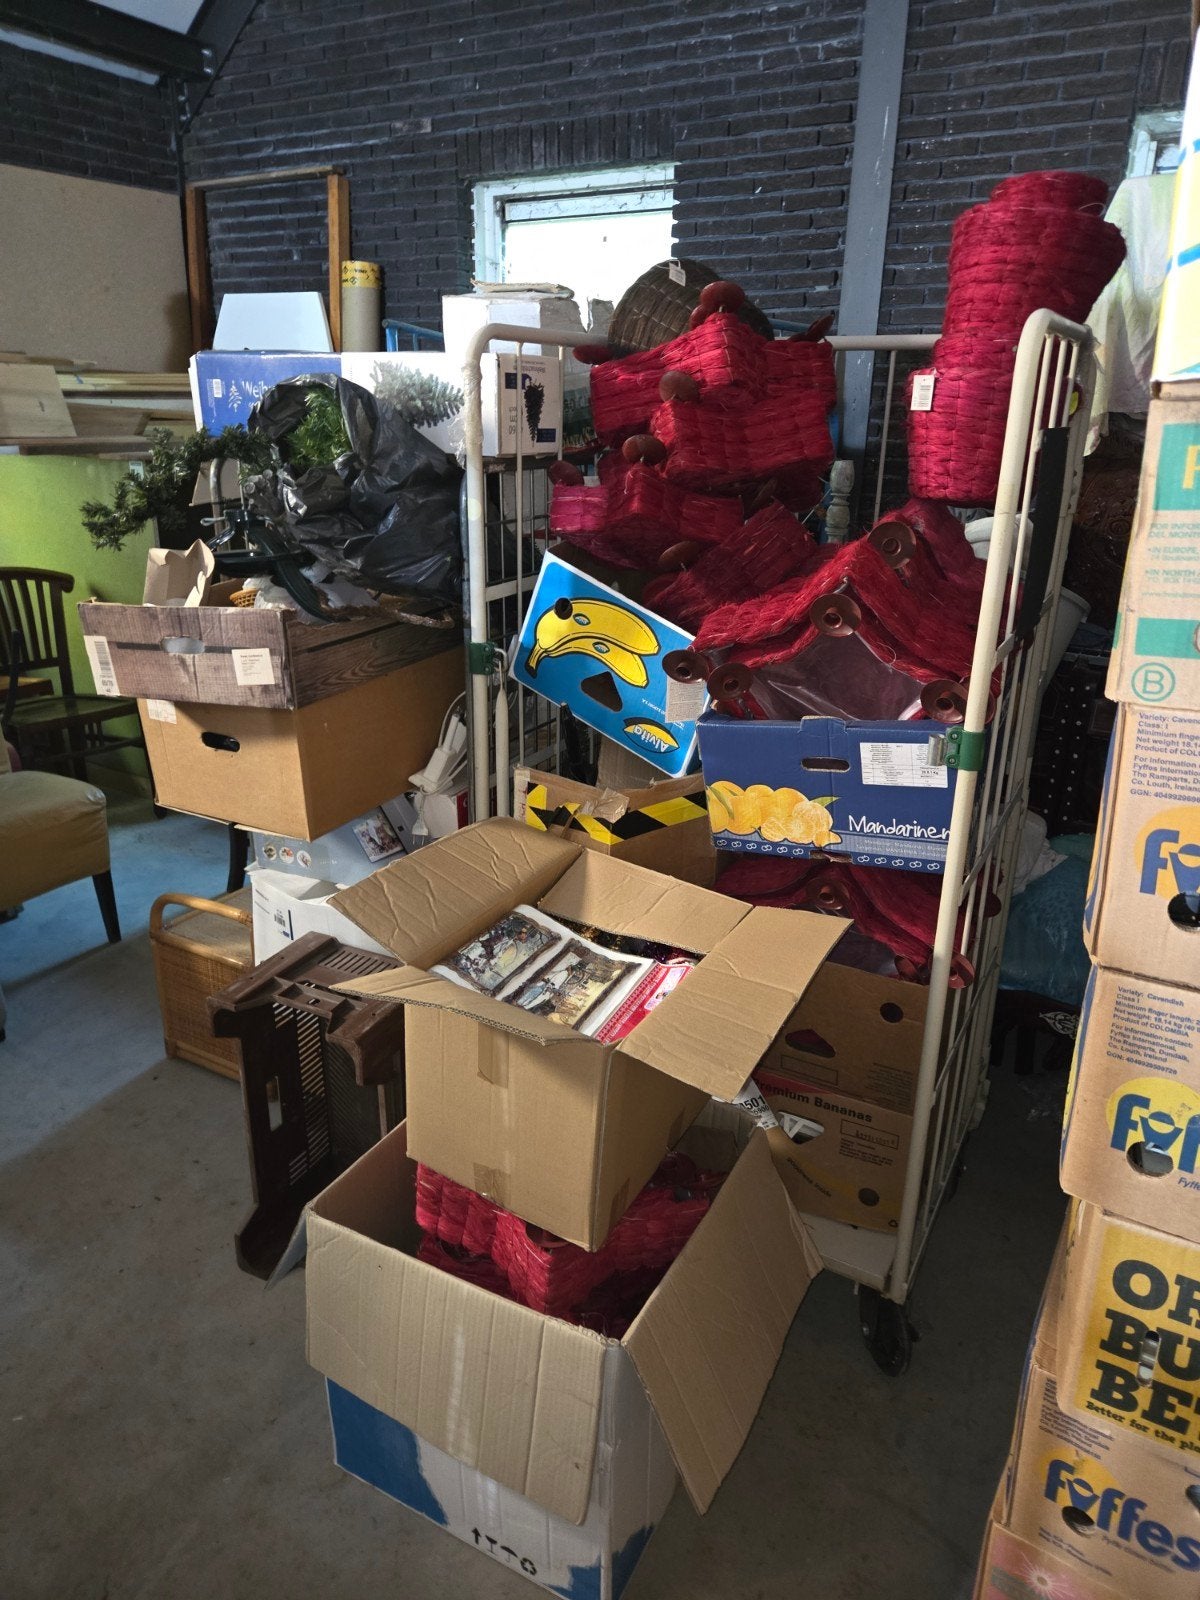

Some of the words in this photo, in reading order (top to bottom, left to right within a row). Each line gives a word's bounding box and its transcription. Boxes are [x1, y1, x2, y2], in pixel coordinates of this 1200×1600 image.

[1139, 712, 1169, 722] Variety:
[1138, 720, 1163, 729] Class:
[633, 725, 669, 752] Alvita
[1152, 739, 1179, 747] weight
[1136, 744, 1167, 753] Product
[1133, 762, 1157, 771] Fyffes
[1117, 993, 1135, 1003] Class
[1118, 986, 1144, 998] Variety:
[1147, 993, 1184, 1007] Cavendish
[1115, 1000, 1146, 1012] Minimum
[1148, 1007, 1168, 1017] finger
[1111, 1022, 1123, 1030] For
[1113, 1013, 1139, 1026] Product
[1150, 1023, 1189, 1037] COLOMBIA
[1109, 1035, 1121, 1043] The
[1110, 1029, 1130, 1040] Fyffes
[1144, 1052, 1168, 1063] Ireland
[814, 1097, 873, 1123] Bananas
[1086, 1400, 1126, 1423] Better
[1129, 1418, 1150, 1433] for
[1154, 1429, 1176, 1444] the
